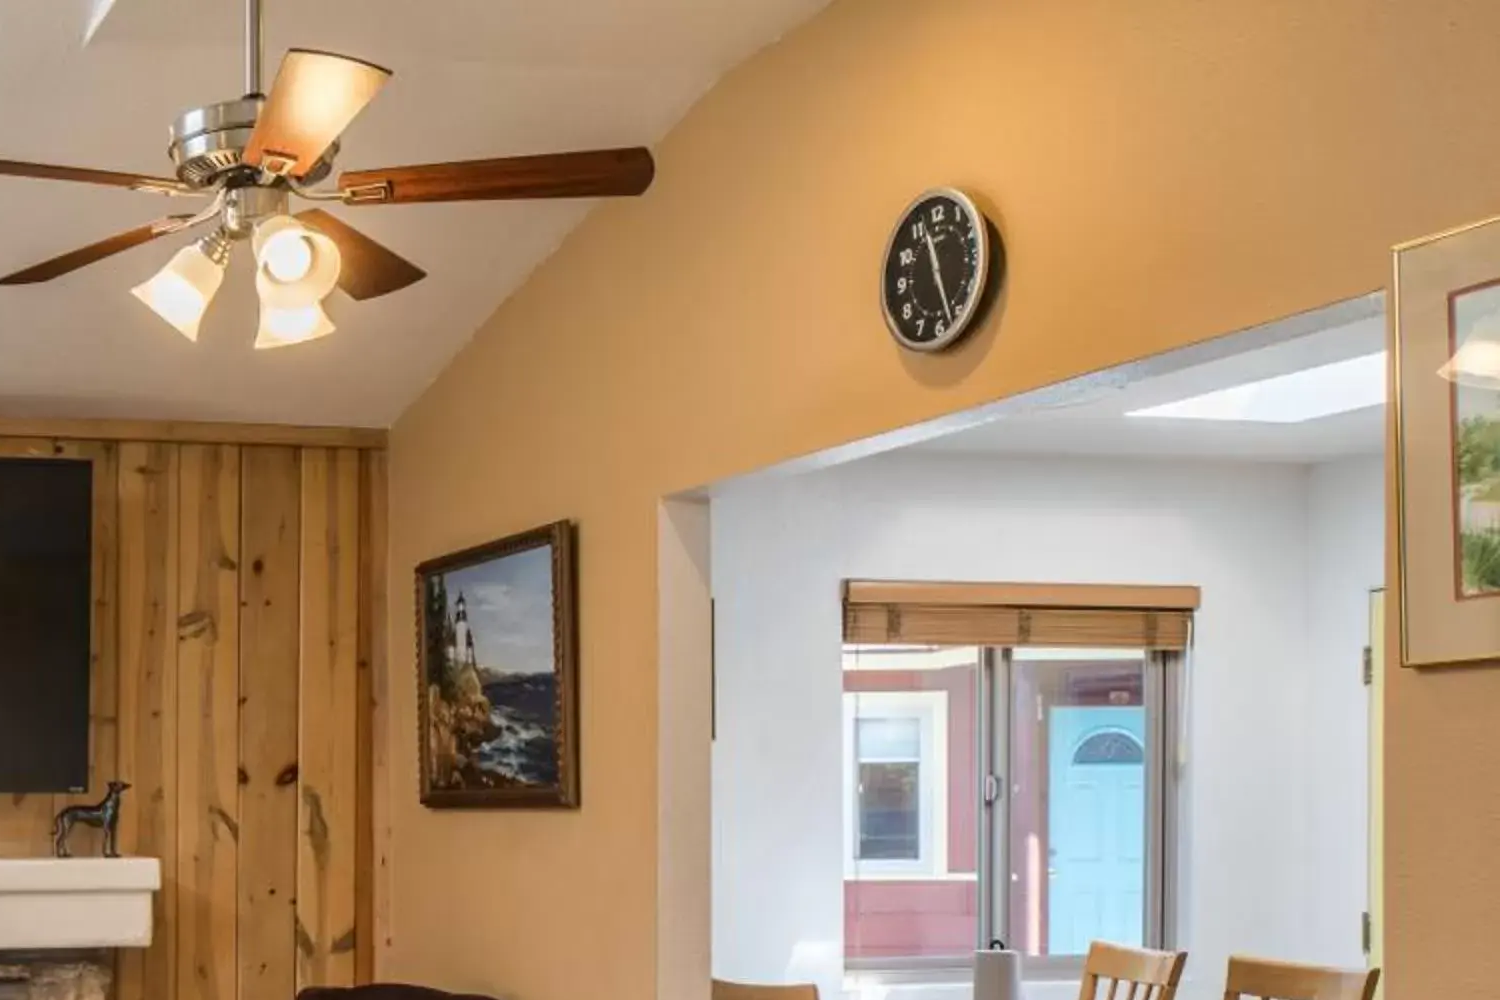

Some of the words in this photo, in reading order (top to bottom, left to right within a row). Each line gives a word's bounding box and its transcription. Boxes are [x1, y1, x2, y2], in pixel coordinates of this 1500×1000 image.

[931, 205, 945, 223] 12
[955, 205, 961, 222] 1
[912, 221, 924, 240] 11
[900, 248, 913, 266] 10
[897, 277, 907, 295] 9
[902, 303, 912, 320] 8
[916, 319, 925, 336] 7
[935, 319, 945, 337] 6
